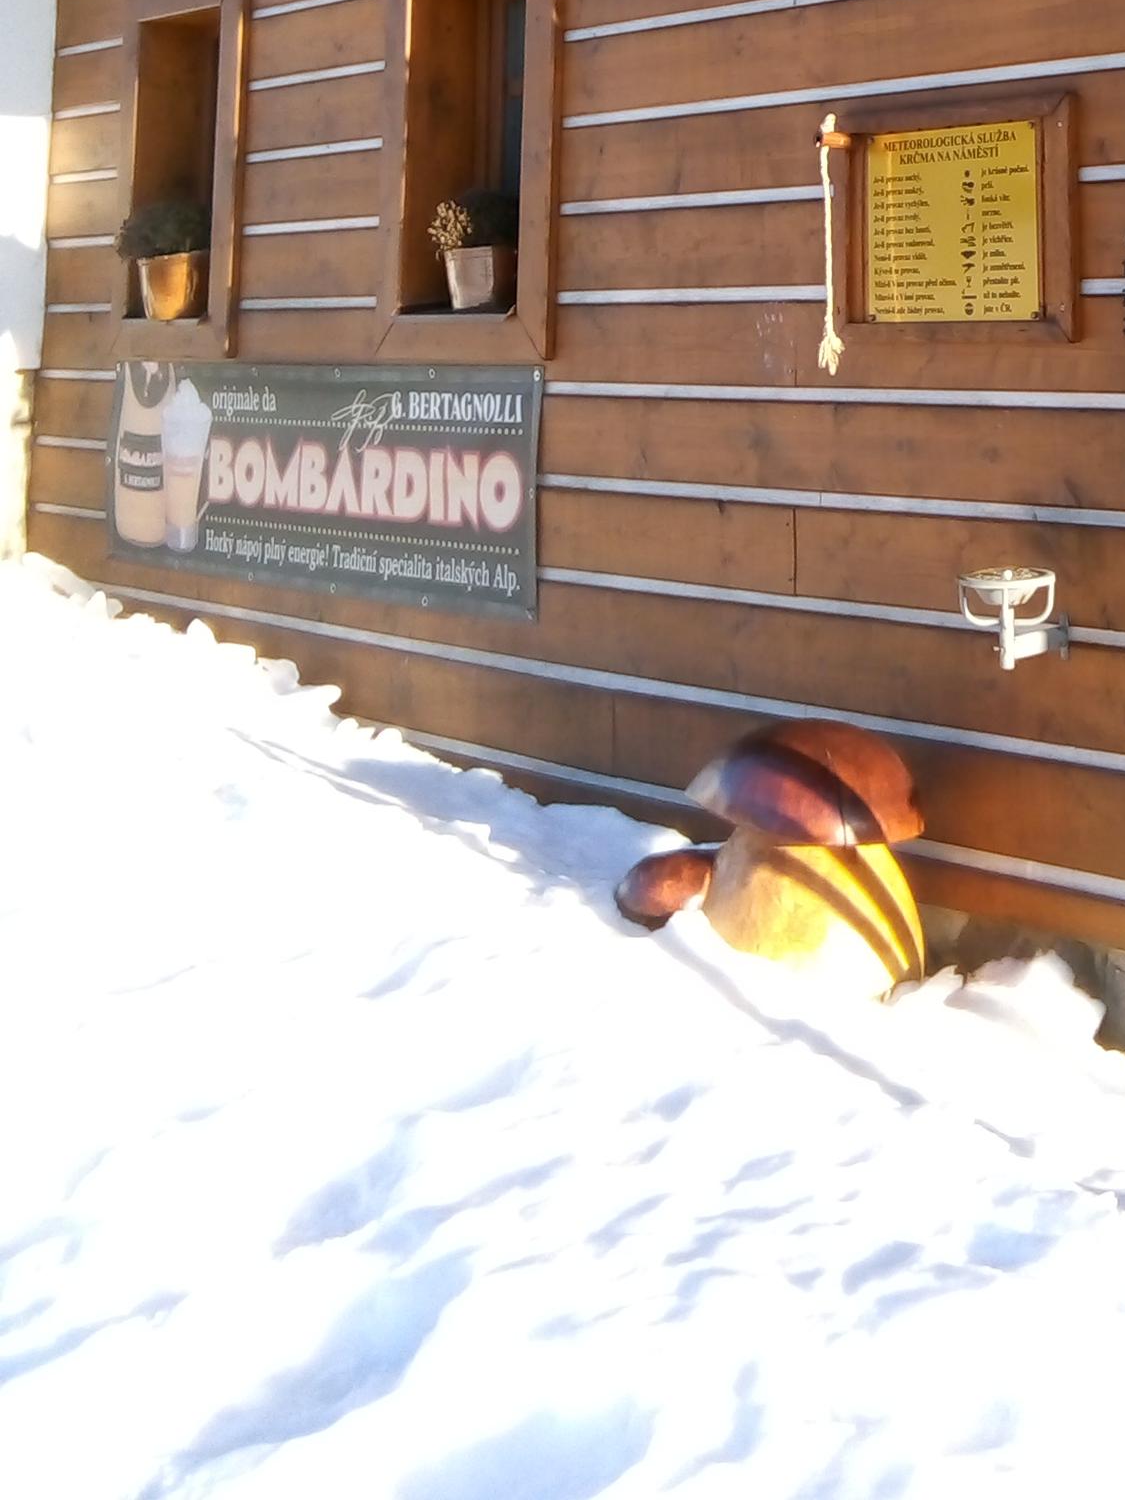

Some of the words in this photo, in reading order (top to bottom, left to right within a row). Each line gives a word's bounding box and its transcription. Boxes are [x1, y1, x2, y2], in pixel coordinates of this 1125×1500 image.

[883, 132, 975, 152] METEOROLOGICKÁ
[977, 129, 1016, 144] SLUŽBA
[899, 149, 936, 165] KRČMA
[936, 150, 951, 162] NA
[952, 144, 999, 161] NÁMĚSTÍ
[212, 386, 260, 417] originale
[262, 390, 277, 412] da
[409, 390, 524, 423] BERTAGNOLLI
[207, 435, 524, 532] BOMBARDINO
[205, 528, 234, 559] Horký
[235, 534, 263, 563] nápoj
[264, 536, 287, 567] plný
[288, 541, 330, 571] energie!
[332, 544, 378, 574] Tradiční
[378, 552, 433, 581] specialita
[435, 555, 490, 592] italských
[493, 563, 521, 597] Alp.
